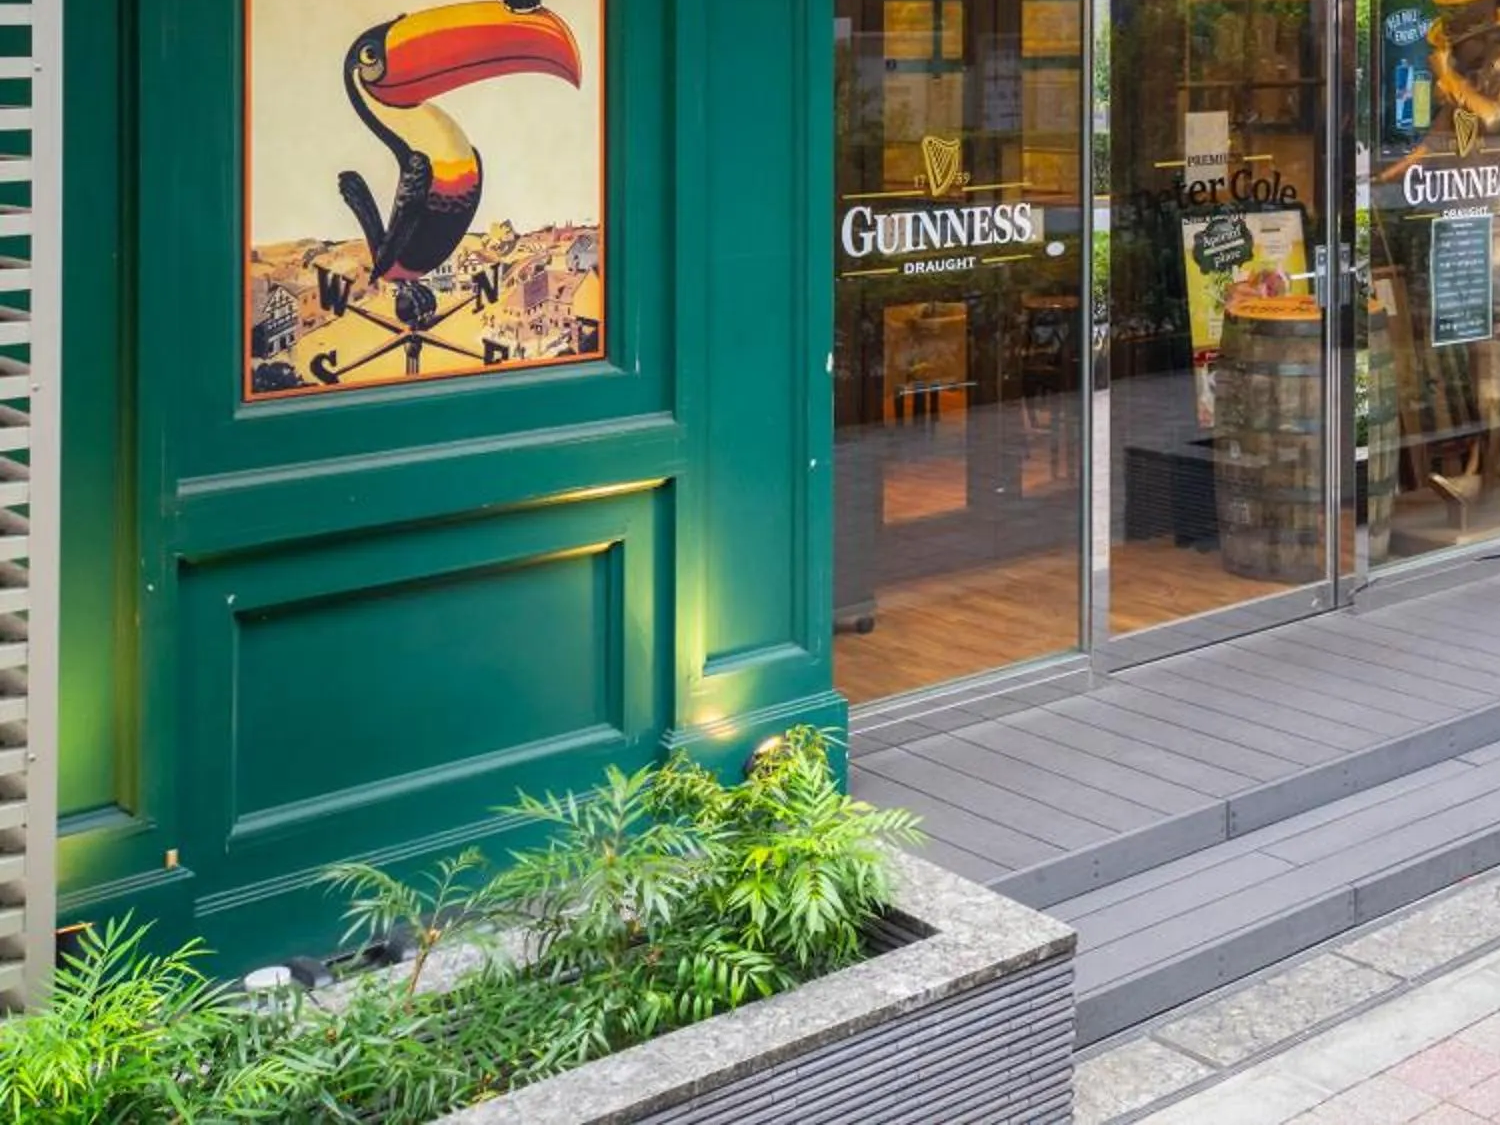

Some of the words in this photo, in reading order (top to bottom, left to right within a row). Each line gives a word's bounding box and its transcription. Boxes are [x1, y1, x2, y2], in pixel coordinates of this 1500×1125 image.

[1230, 168, 1297, 206] Cole
[840, 202, 1034, 258] GUINNESS
[903, 256, 977, 275] DRAUGHT
